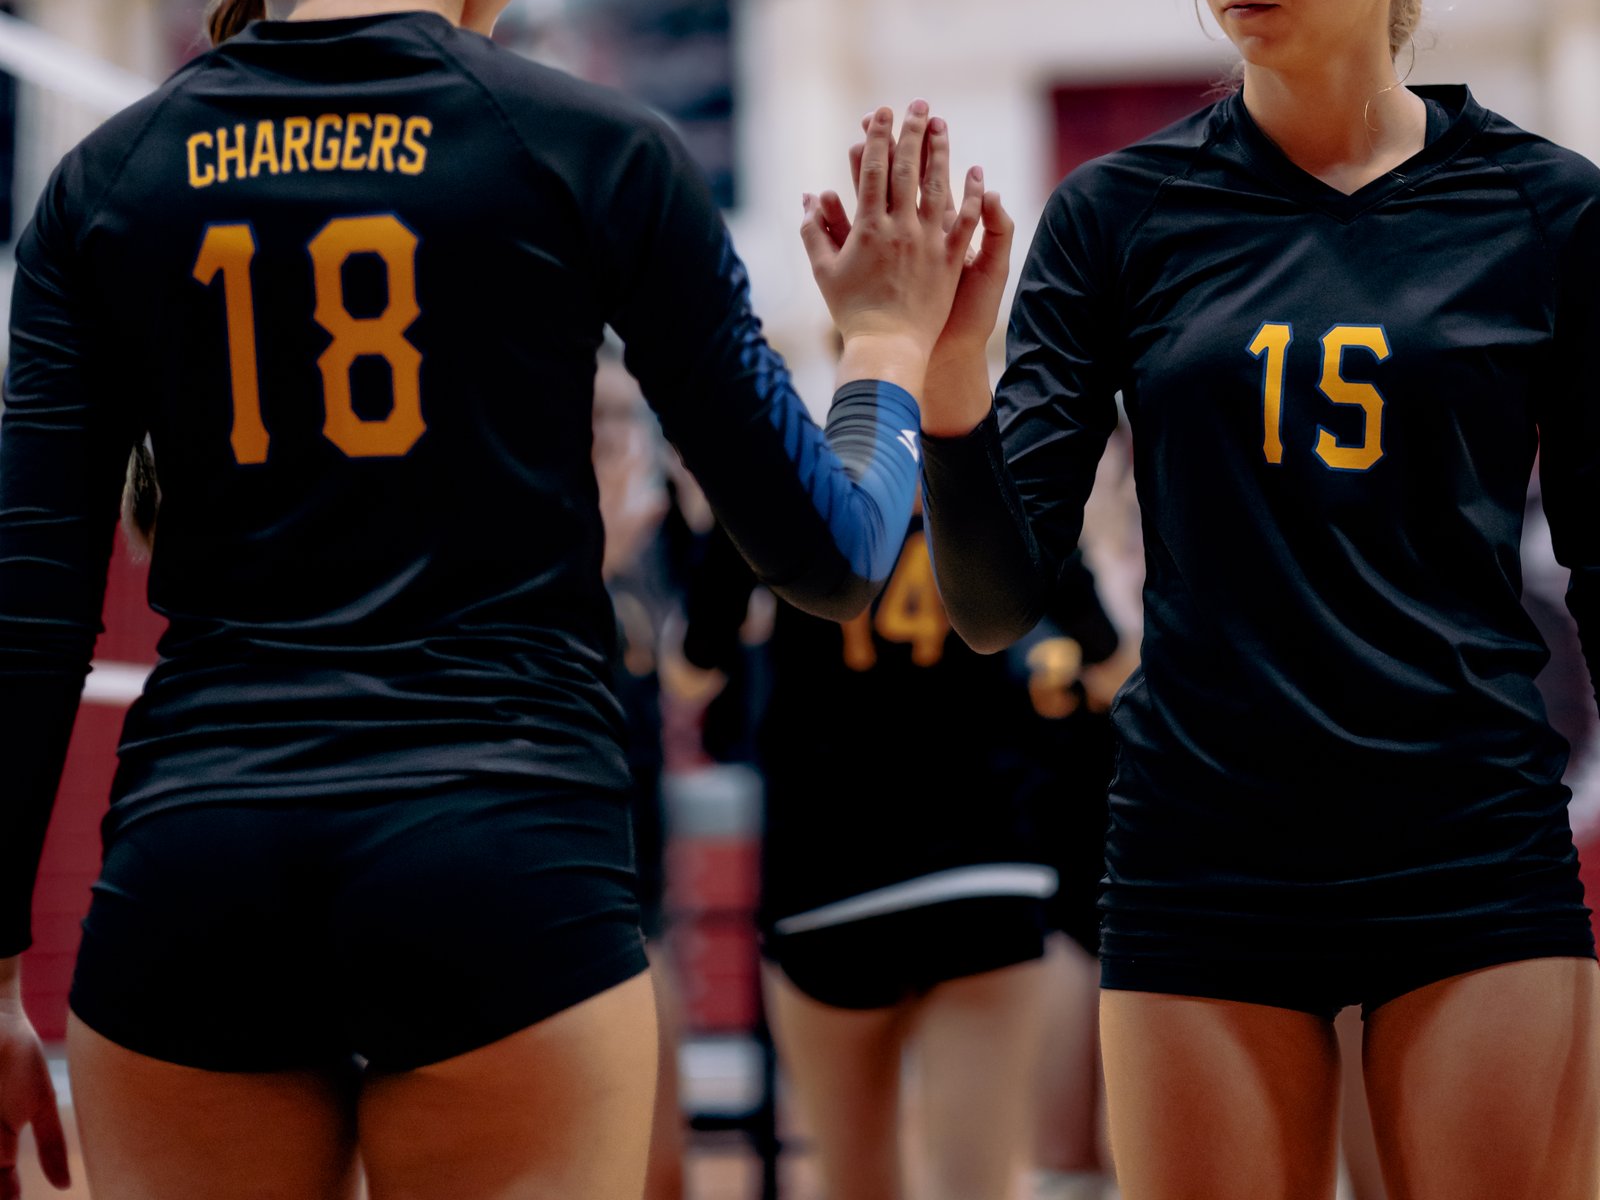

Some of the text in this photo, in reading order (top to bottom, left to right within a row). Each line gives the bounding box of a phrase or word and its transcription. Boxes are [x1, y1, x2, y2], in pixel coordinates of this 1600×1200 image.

[186, 112, 433, 188] CHARGERS
[191, 212, 429, 465] 18
[1246, 321, 1392, 473] 15
